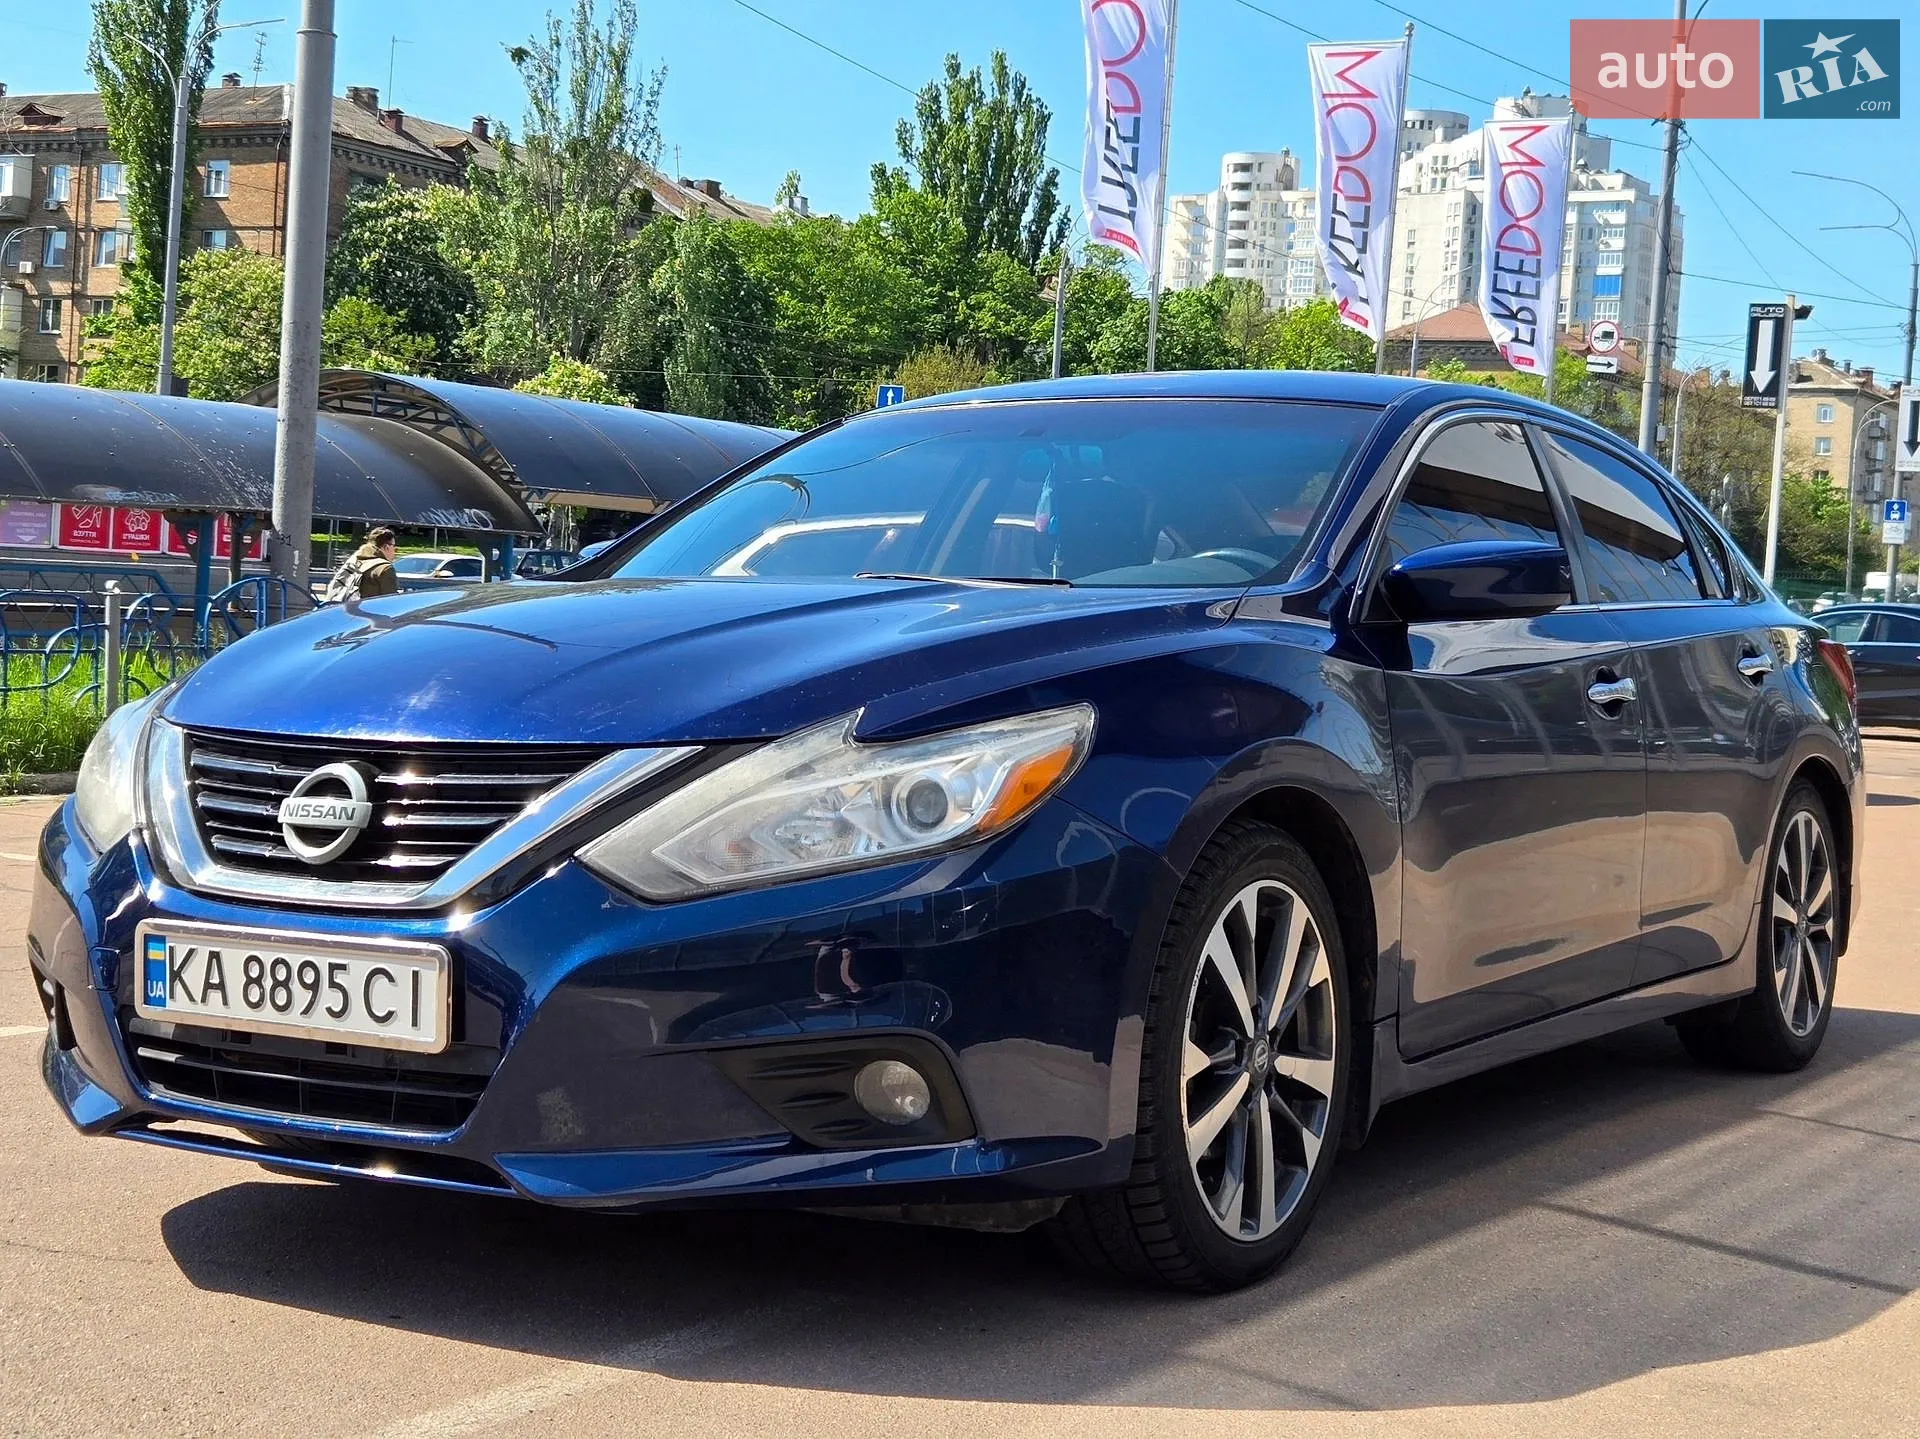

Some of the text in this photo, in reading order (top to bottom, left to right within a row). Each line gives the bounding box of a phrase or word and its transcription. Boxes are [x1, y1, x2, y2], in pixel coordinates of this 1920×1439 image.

[283, 803, 357, 821] NISSAN
[147, 979, 165, 999] UA
[168, 944, 420, 1028] KA 8895 CI
